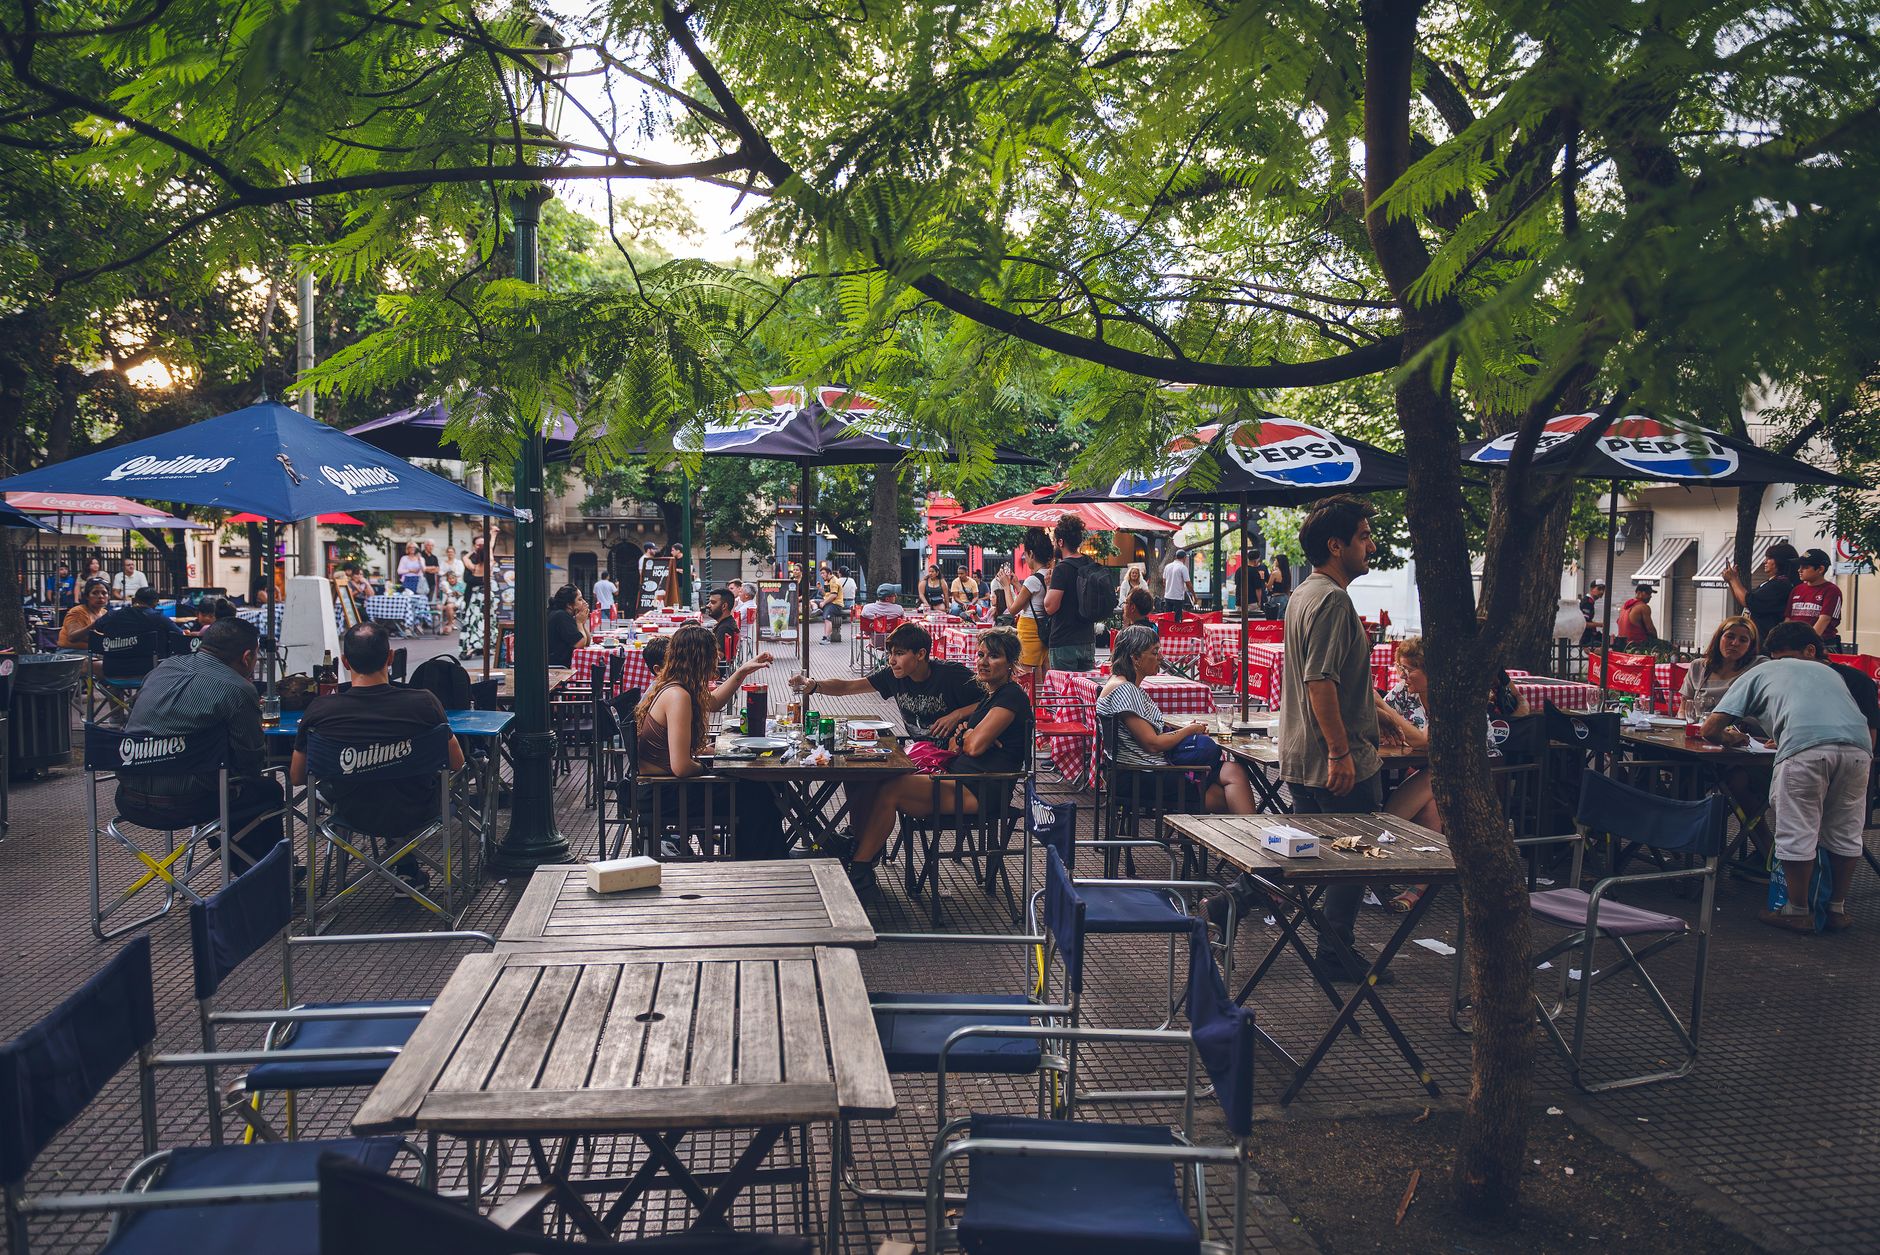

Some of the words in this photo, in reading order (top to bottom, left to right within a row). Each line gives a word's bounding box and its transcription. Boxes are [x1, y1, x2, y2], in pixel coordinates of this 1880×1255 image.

[1242, 441, 1345, 465] PEPSI
[1605, 438, 1726, 456] PEPSI
[102, 454, 236, 482] Quilmes
[319, 463, 400, 496] Quilmes
[102, 636, 138, 652] Quilmes
[1493, 728, 1509, 736] EPSI
[118, 735, 187, 766] Quilmes
[339, 738, 413, 775] Quilmes
